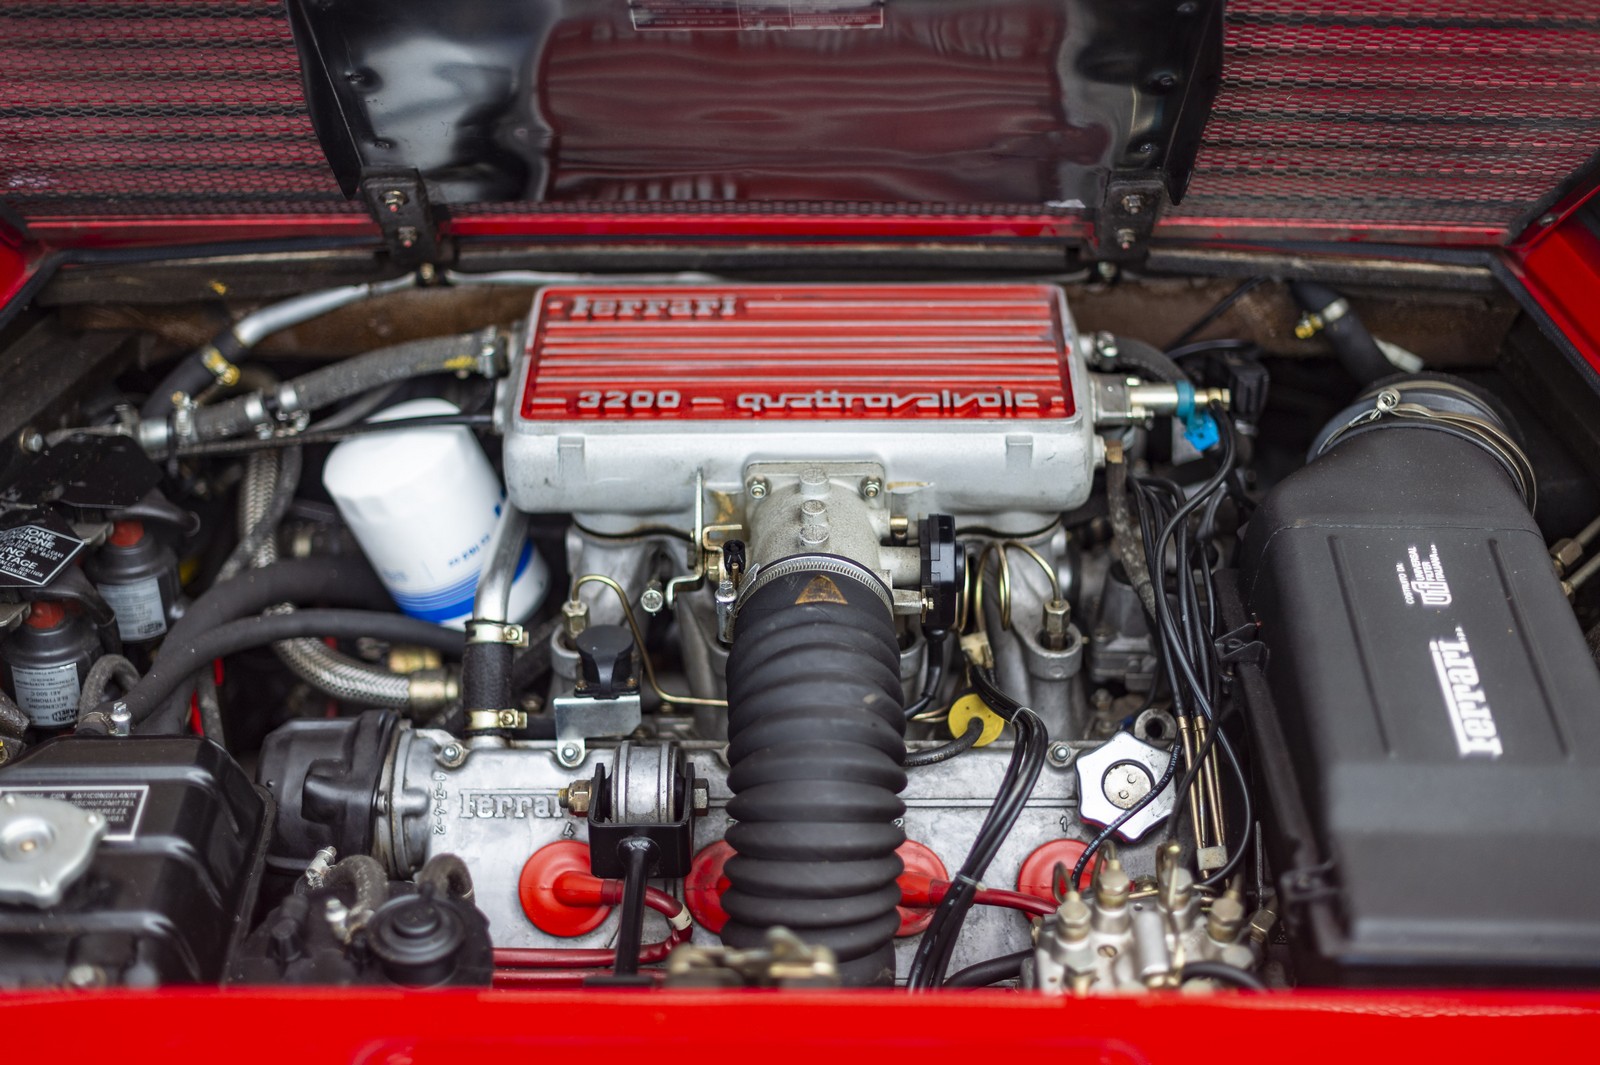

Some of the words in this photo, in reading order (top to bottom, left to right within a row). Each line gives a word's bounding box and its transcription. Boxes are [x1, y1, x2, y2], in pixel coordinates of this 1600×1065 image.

[577, 390, 682, 410] 3200
[736, 389, 1041, 414] quattrovalvole
[1407, 546, 1425, 582] UNIVERSAL
[1421, 561, 1436, 582] FILTER
[1428, 639, 1504, 757] Ferrari
[459, 788, 565, 819] Ferrar
[560, 821, 575, 838] 4
